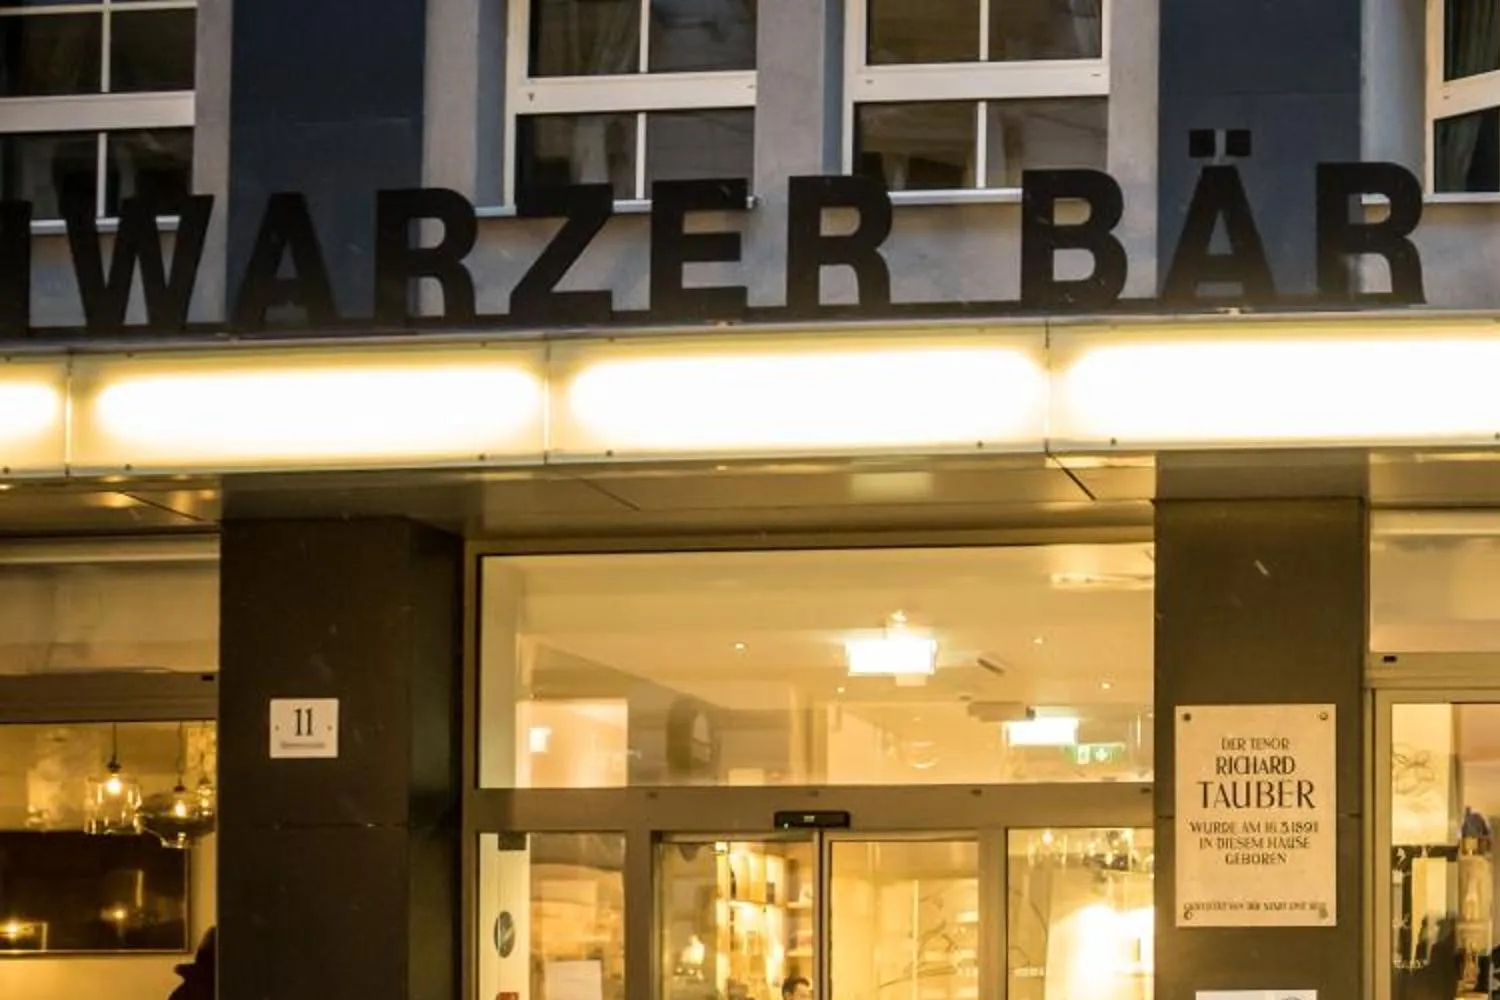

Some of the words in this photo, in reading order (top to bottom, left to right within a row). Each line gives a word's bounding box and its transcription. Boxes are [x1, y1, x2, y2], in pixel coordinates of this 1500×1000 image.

[1021, 129, 1426, 305] BÄR
[295, 708, 313, 736] 11
[1221, 737, 1247, 750] DER
[1251, 737, 1290, 750] TENOR
[1215, 755, 1296, 775] RICHARD
[1198, 780, 1316, 809] TAUBER
[1199, 837, 1213, 849] IN
[1225, 852, 1287, 866] GEBOREN
